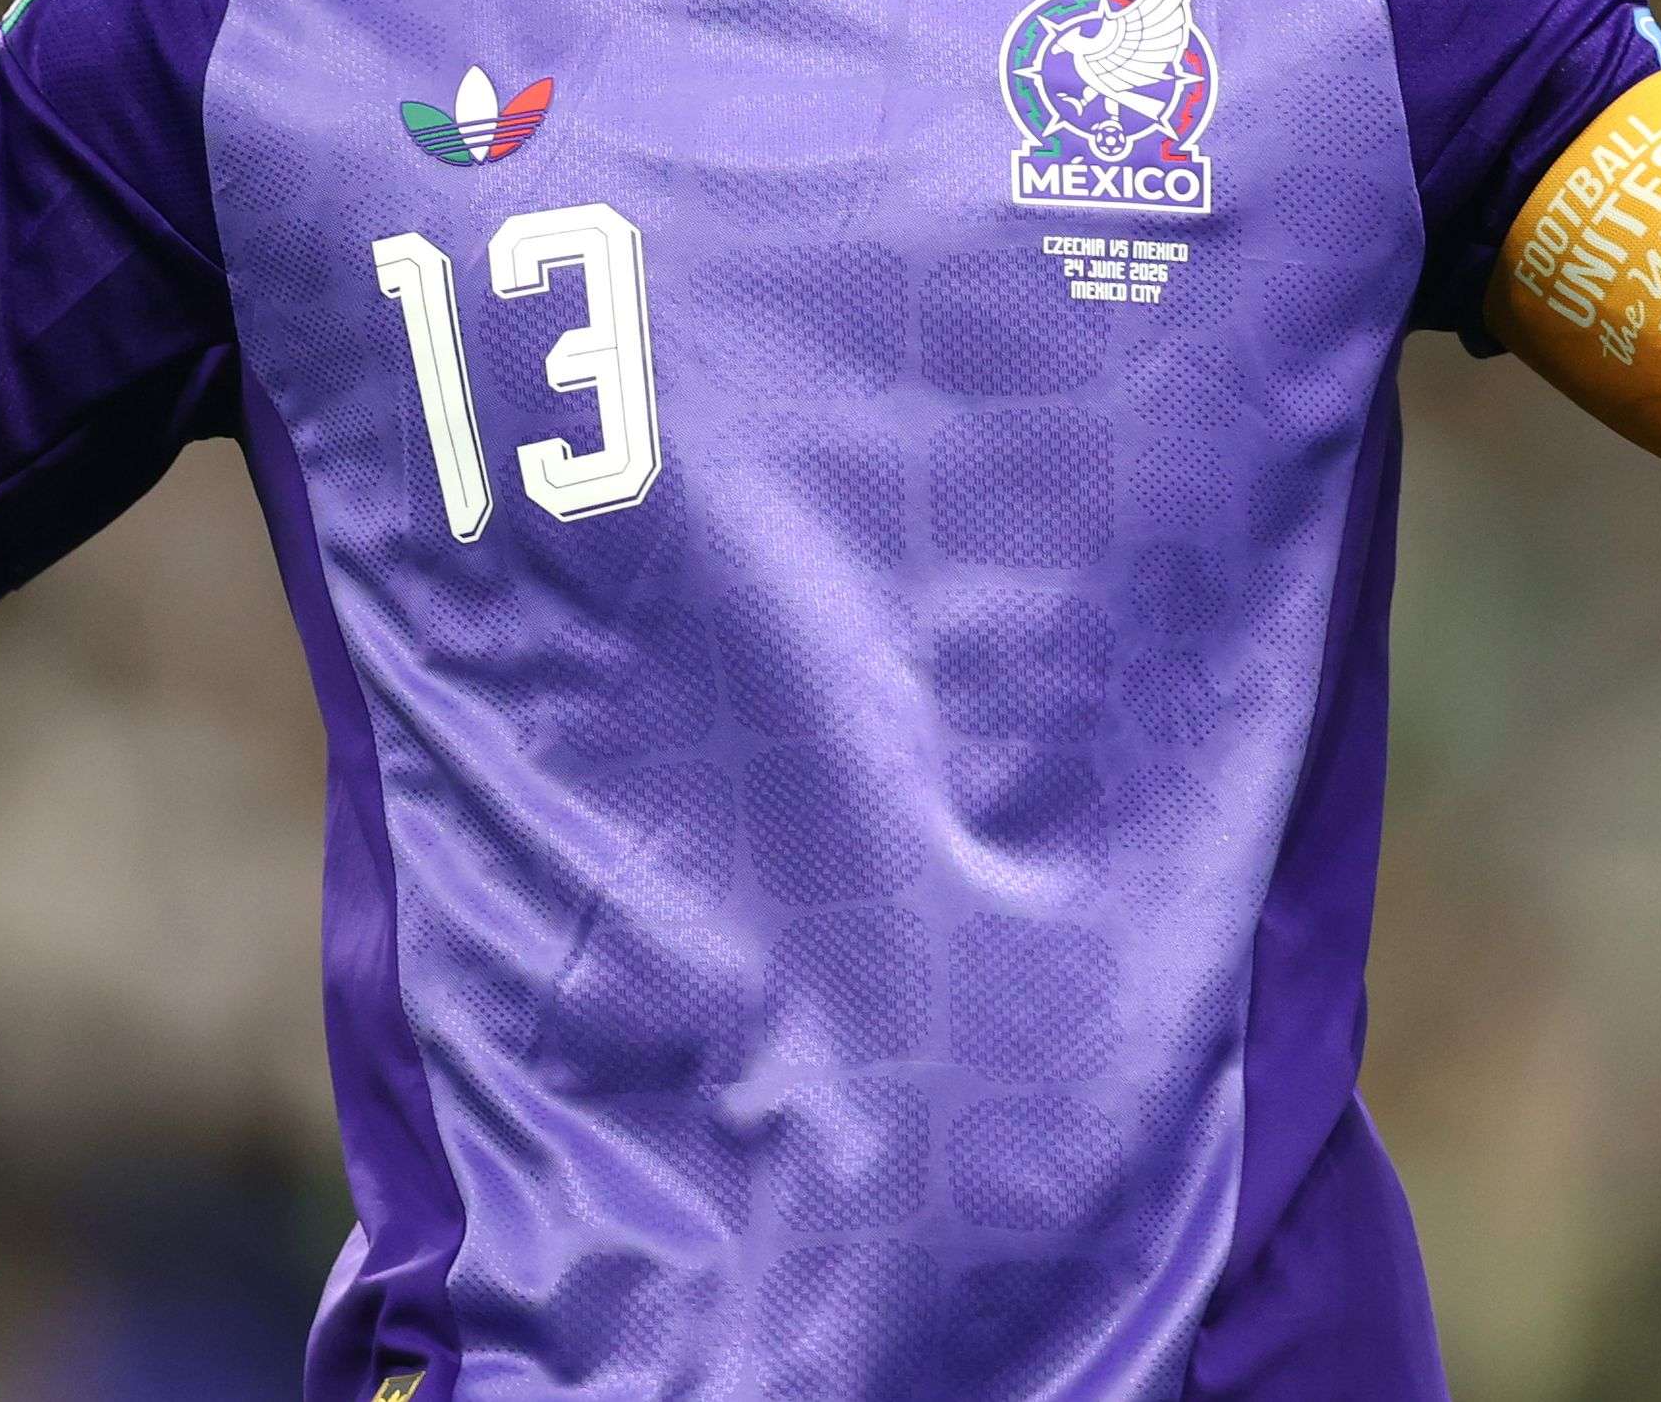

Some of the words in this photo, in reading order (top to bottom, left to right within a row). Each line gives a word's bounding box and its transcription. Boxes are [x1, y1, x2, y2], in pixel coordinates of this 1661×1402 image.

[1022, 156, 1200, 202] MÉXICO
[1043, 236, 1105, 257] CZECHIA
[1109, 239, 1129, 258] VS
[1132, 240, 1189, 262] MEXICO
[1064, 258, 1084, 277] 24
[1087, 259, 1126, 279] JUNE
[1129, 262, 1169, 282] 2026
[1070, 280, 1127, 301] MEXICO
[1130, 283, 1162, 304] CITY
[1599, 300, 1645, 366] the
[371, 202, 662, 544] 13
